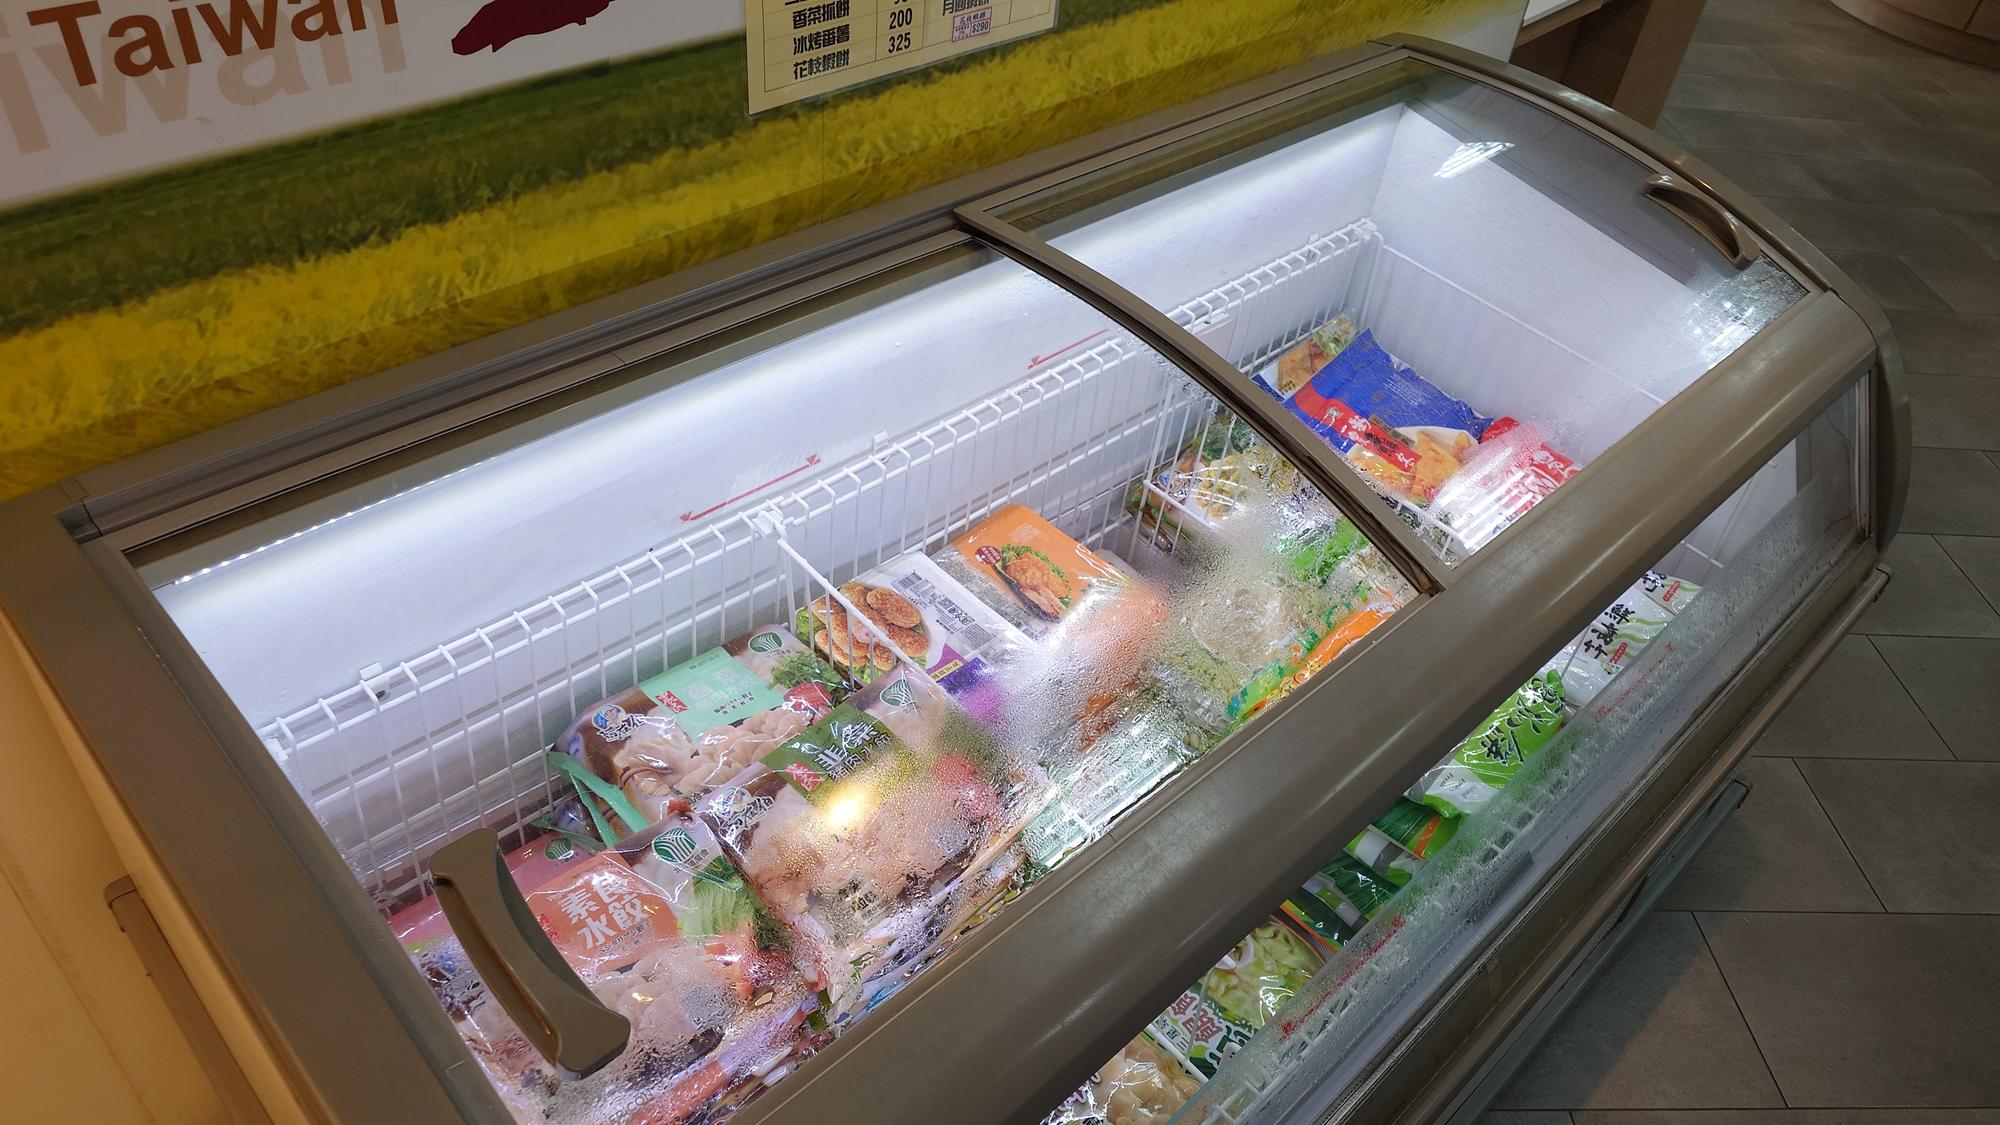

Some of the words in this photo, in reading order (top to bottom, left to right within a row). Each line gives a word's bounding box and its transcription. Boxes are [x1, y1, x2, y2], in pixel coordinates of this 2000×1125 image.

[793, 0, 850, 29] 香菜抓餅
[889, 8, 913, 29] 200
[27, 0, 399, 87] Taiwan
[793, 24, 850, 55] 冰烤番薯
[888, 32, 911, 53] 325
[793, 49, 850, 80] 花枝蝦餅
[558, 872, 629, 925] 素食
[576, 893, 651, 950] 水餃
